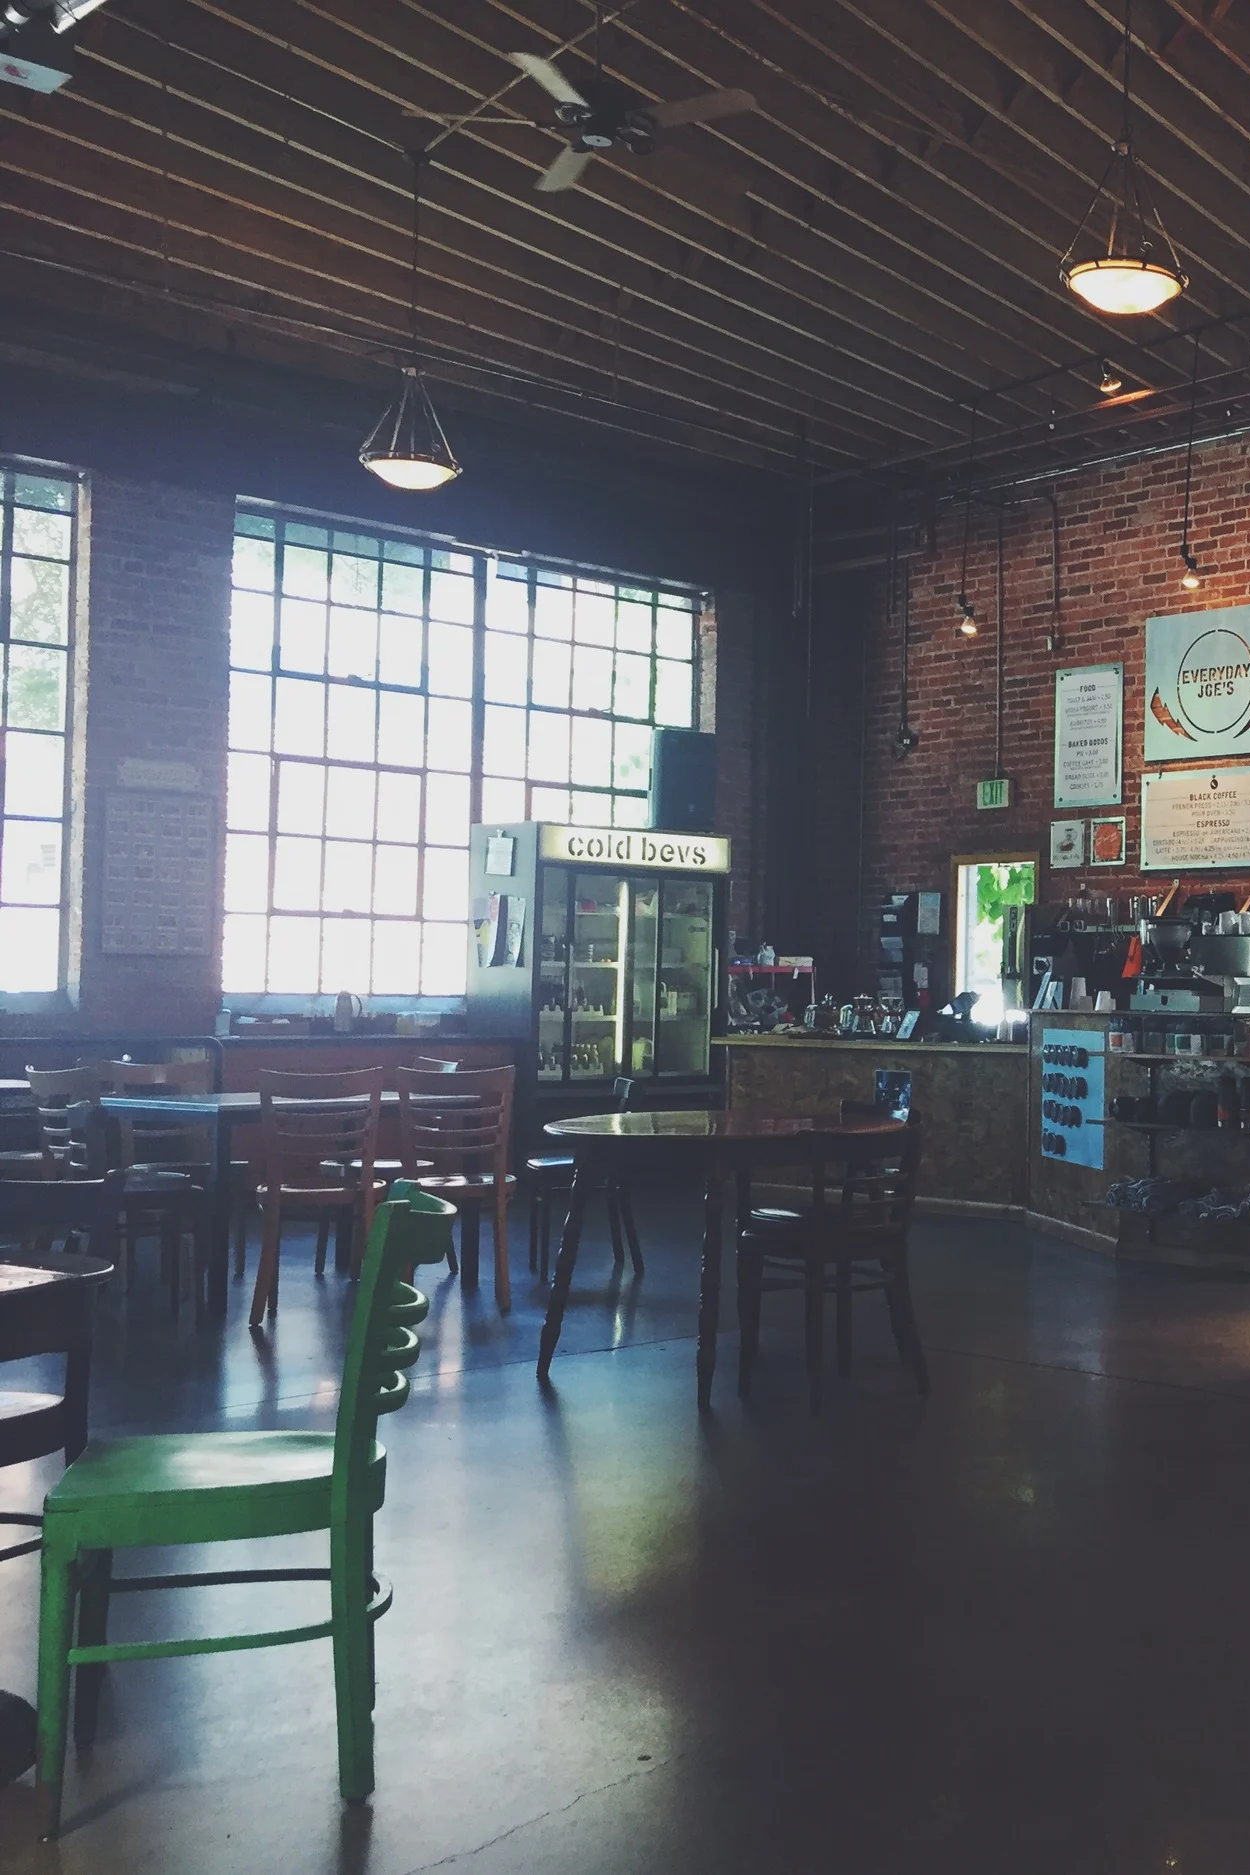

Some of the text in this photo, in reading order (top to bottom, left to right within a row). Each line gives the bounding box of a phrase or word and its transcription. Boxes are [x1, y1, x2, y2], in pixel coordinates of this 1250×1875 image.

[1182, 663, 1250, 684] EVERYDAY
[1080, 684, 1096, 692] FOOD
[1197, 681, 1234, 698] JOE'S
[1068, 737, 1108, 748] BAKED GOODS
[983, 781, 1004, 806] EXIT
[1189, 791, 1237, 801] BLACK COFFEE
[1196, 819, 1230, 828] ESPRESSO
[568, 834, 706, 865] cold bevs
